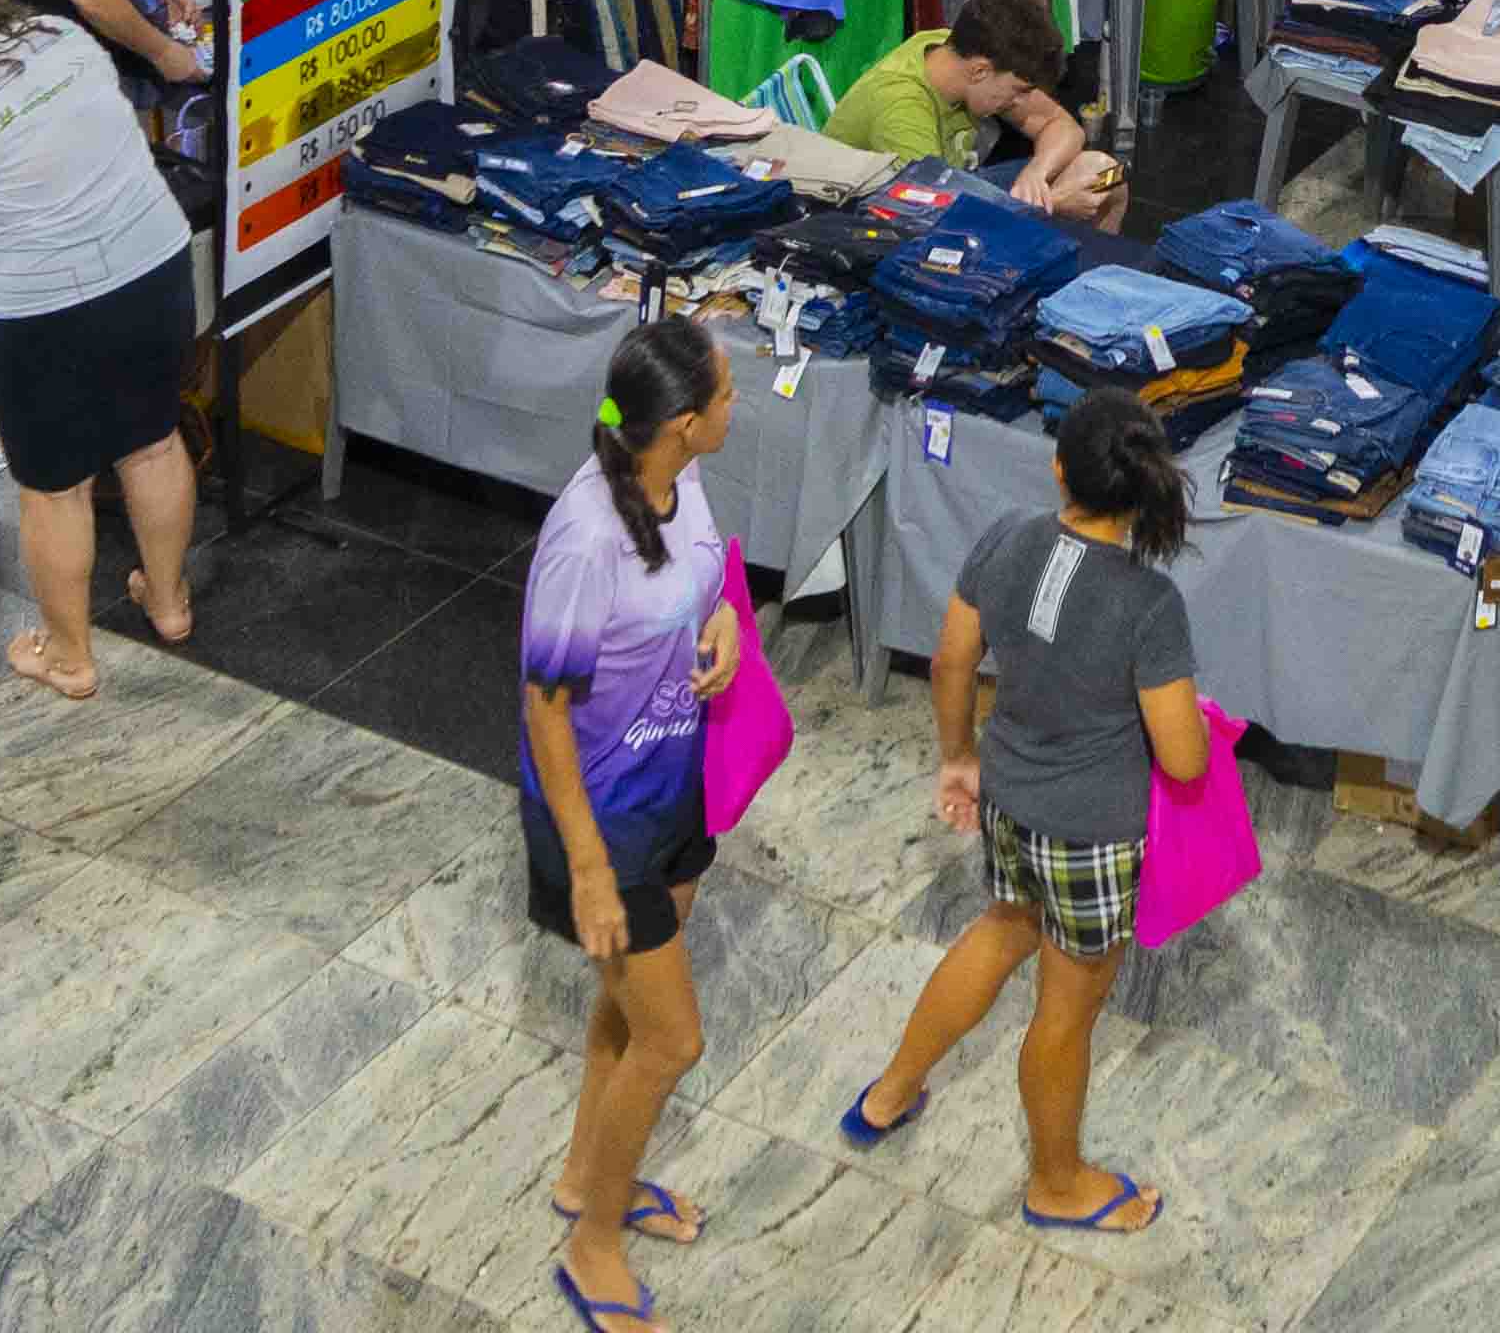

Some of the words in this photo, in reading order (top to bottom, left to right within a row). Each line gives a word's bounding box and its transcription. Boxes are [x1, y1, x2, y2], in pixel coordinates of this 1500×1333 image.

[305, 11, 326, 43] R$
[300, 56, 319, 86] R$
[327, 19, 386, 69] 100,00
[300, 137, 319, 168] R$
